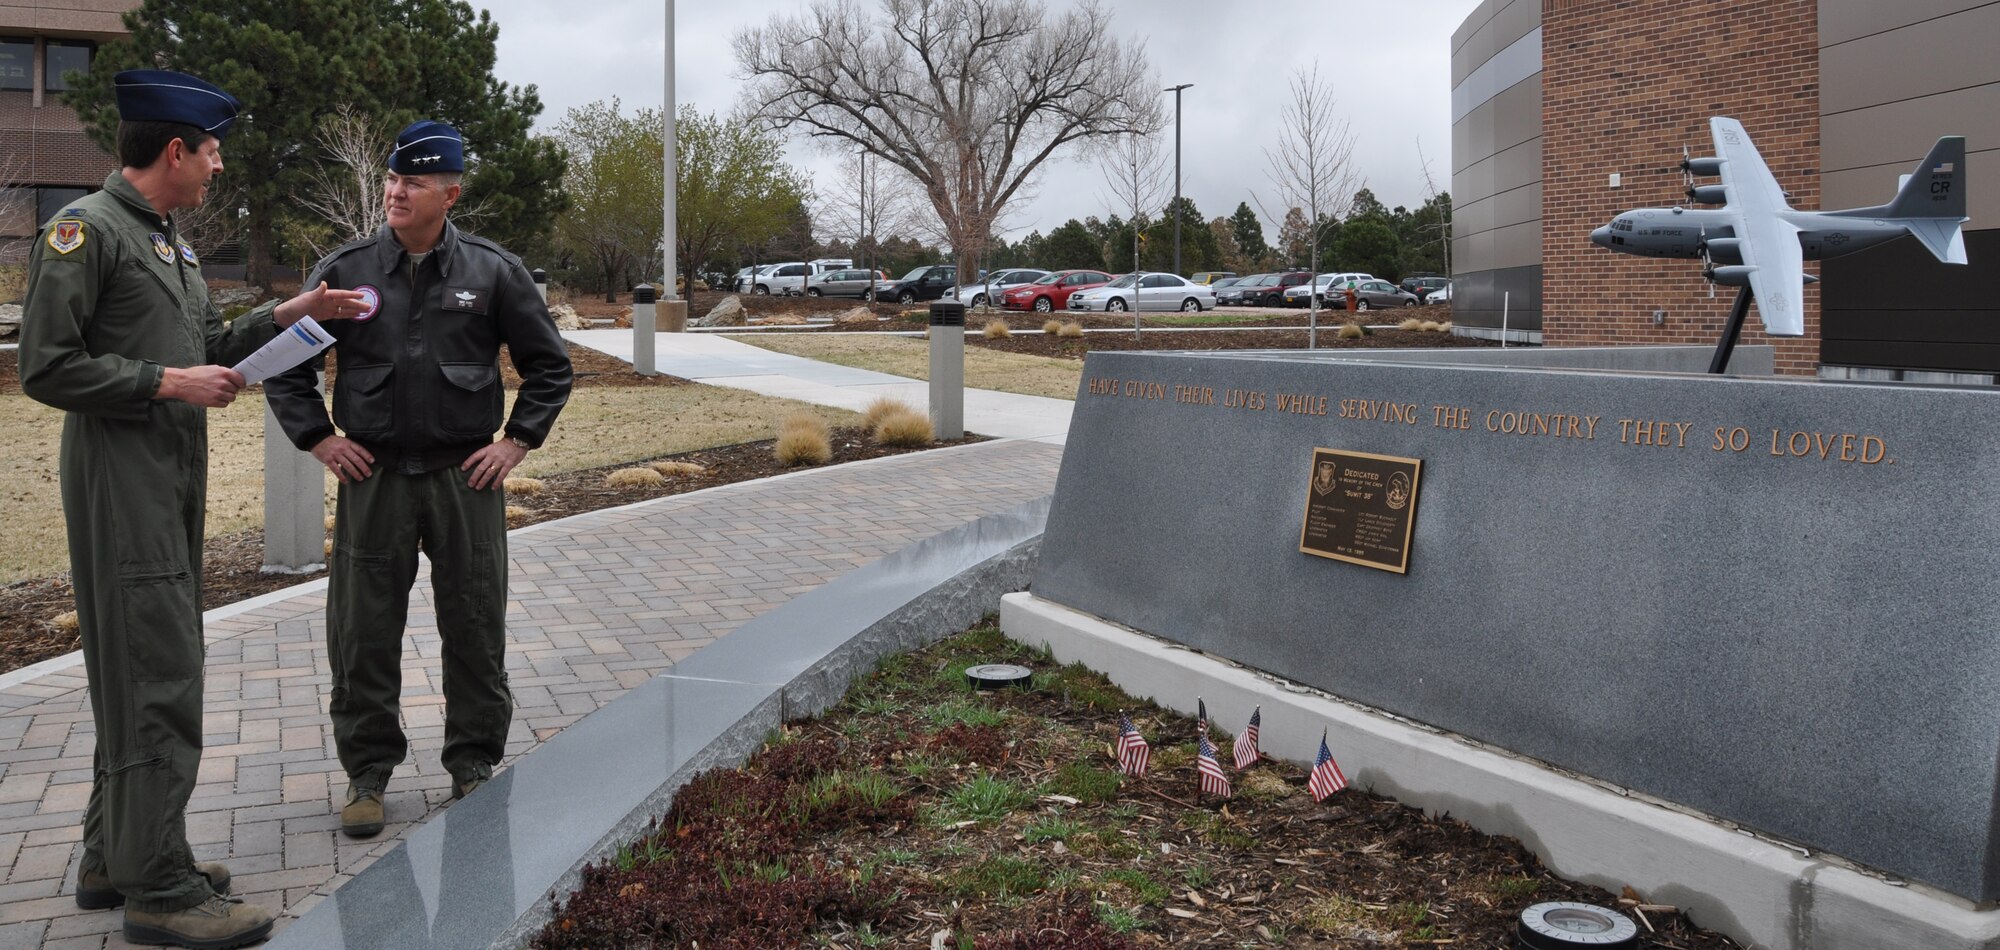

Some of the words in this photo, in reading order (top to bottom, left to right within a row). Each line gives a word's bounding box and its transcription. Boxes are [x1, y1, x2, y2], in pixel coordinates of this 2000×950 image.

[1930, 181, 1951, 194] CR
[1088, 376, 1119, 396] HAVE
[1125, 379, 1167, 400] GIVEN
[1175, 384, 1216, 405] THEIR
[1224, 388, 1266, 410] LIVES
[1276, 393, 1328, 416] WHILE
[1339, 399, 1418, 424] SERVING
[1433, 405, 1472, 430] THE
[1486, 410, 1600, 439] COUNTRY
[1618, 418, 1693, 447] THEY
[1712, 426, 1750, 452] SO
[1771, 428, 1894, 465] LOVED.
